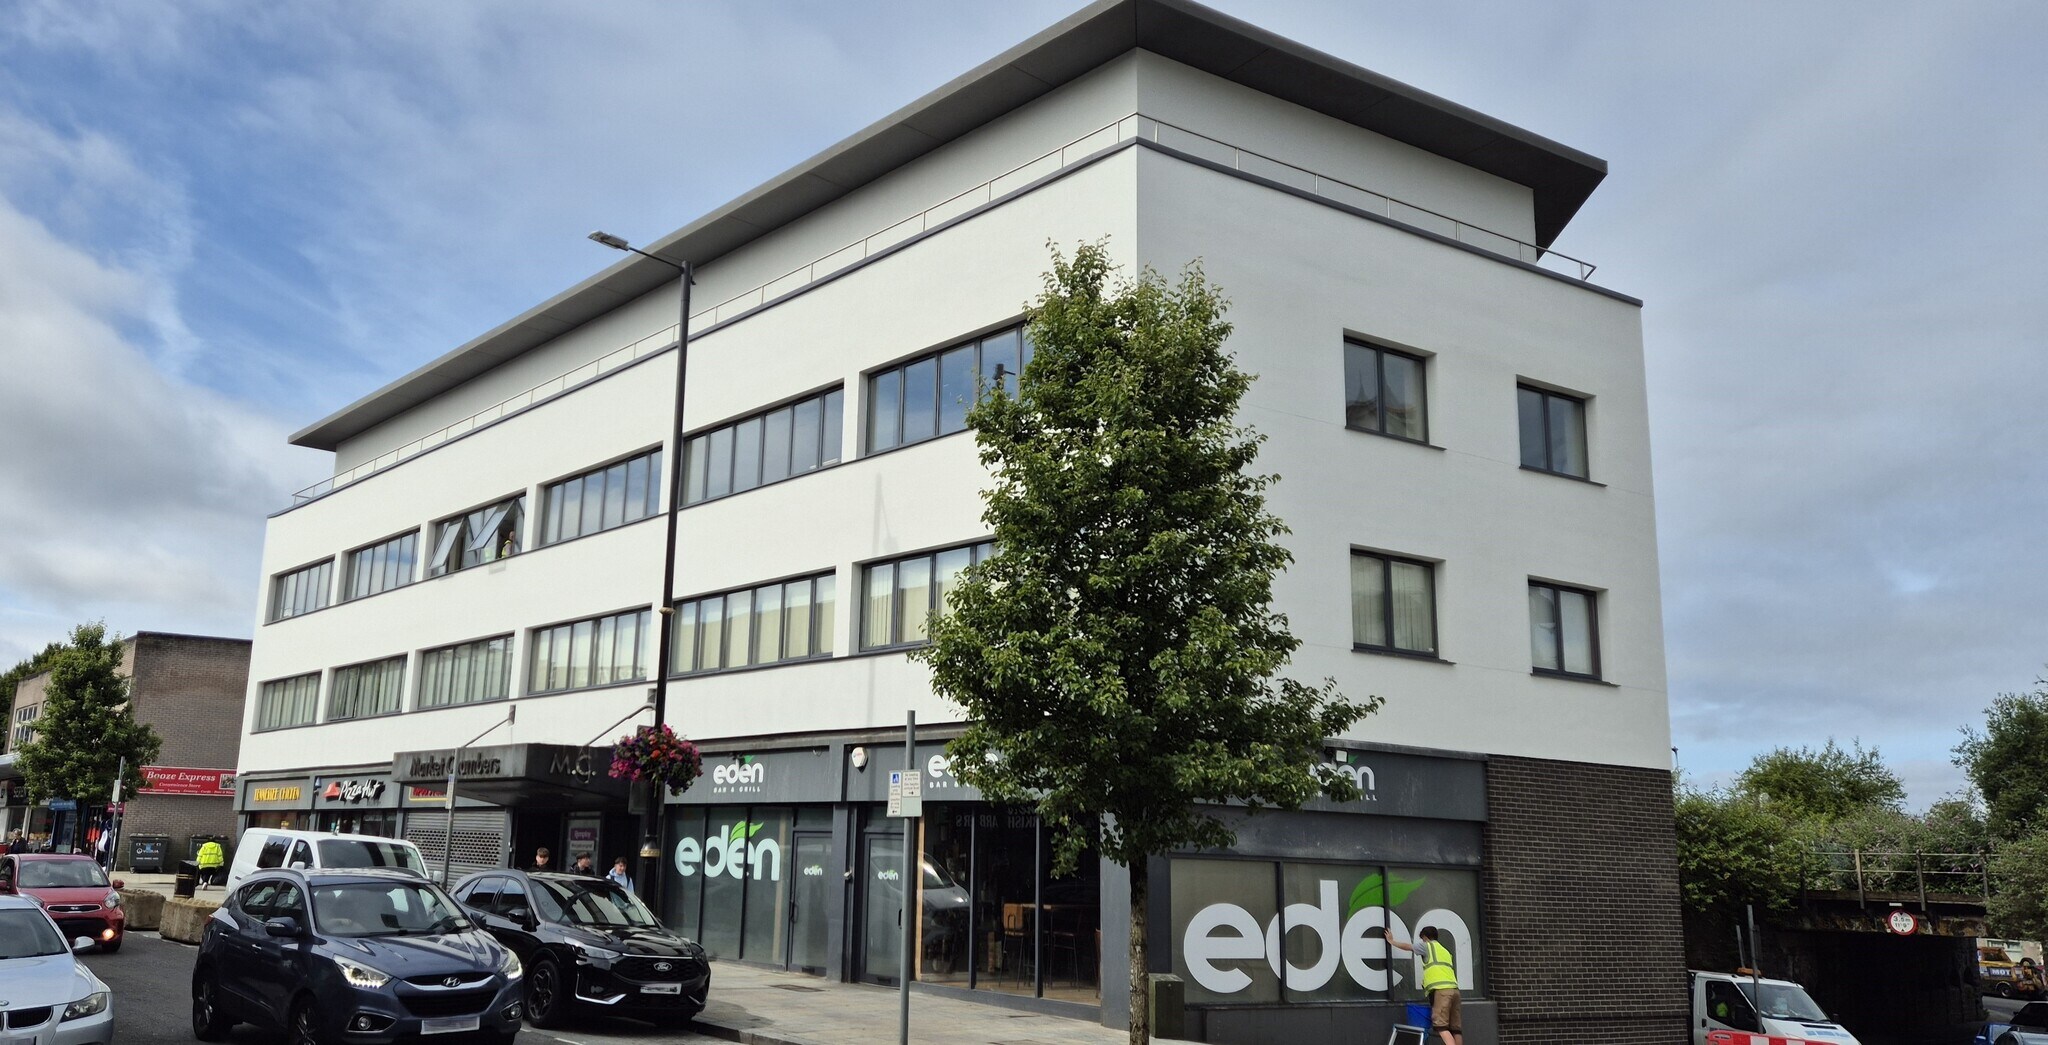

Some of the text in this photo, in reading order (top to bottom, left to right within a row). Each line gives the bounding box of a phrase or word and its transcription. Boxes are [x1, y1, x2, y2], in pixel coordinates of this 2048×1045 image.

[409, 753, 501, 777] Market Cambers
[713, 759, 764, 785] eden
[147, 771, 216, 783] Booze Express
[929, 781, 948, 789] BAR
[338, 779, 380, 801] Pizza Hut
[675, 825, 780, 881] eden
[804, 865, 823, 875] eden
[878, 870, 899, 880] eden
[1183, 880, 1474, 993] eden
[1992, 968, 2011, 976] MOT
